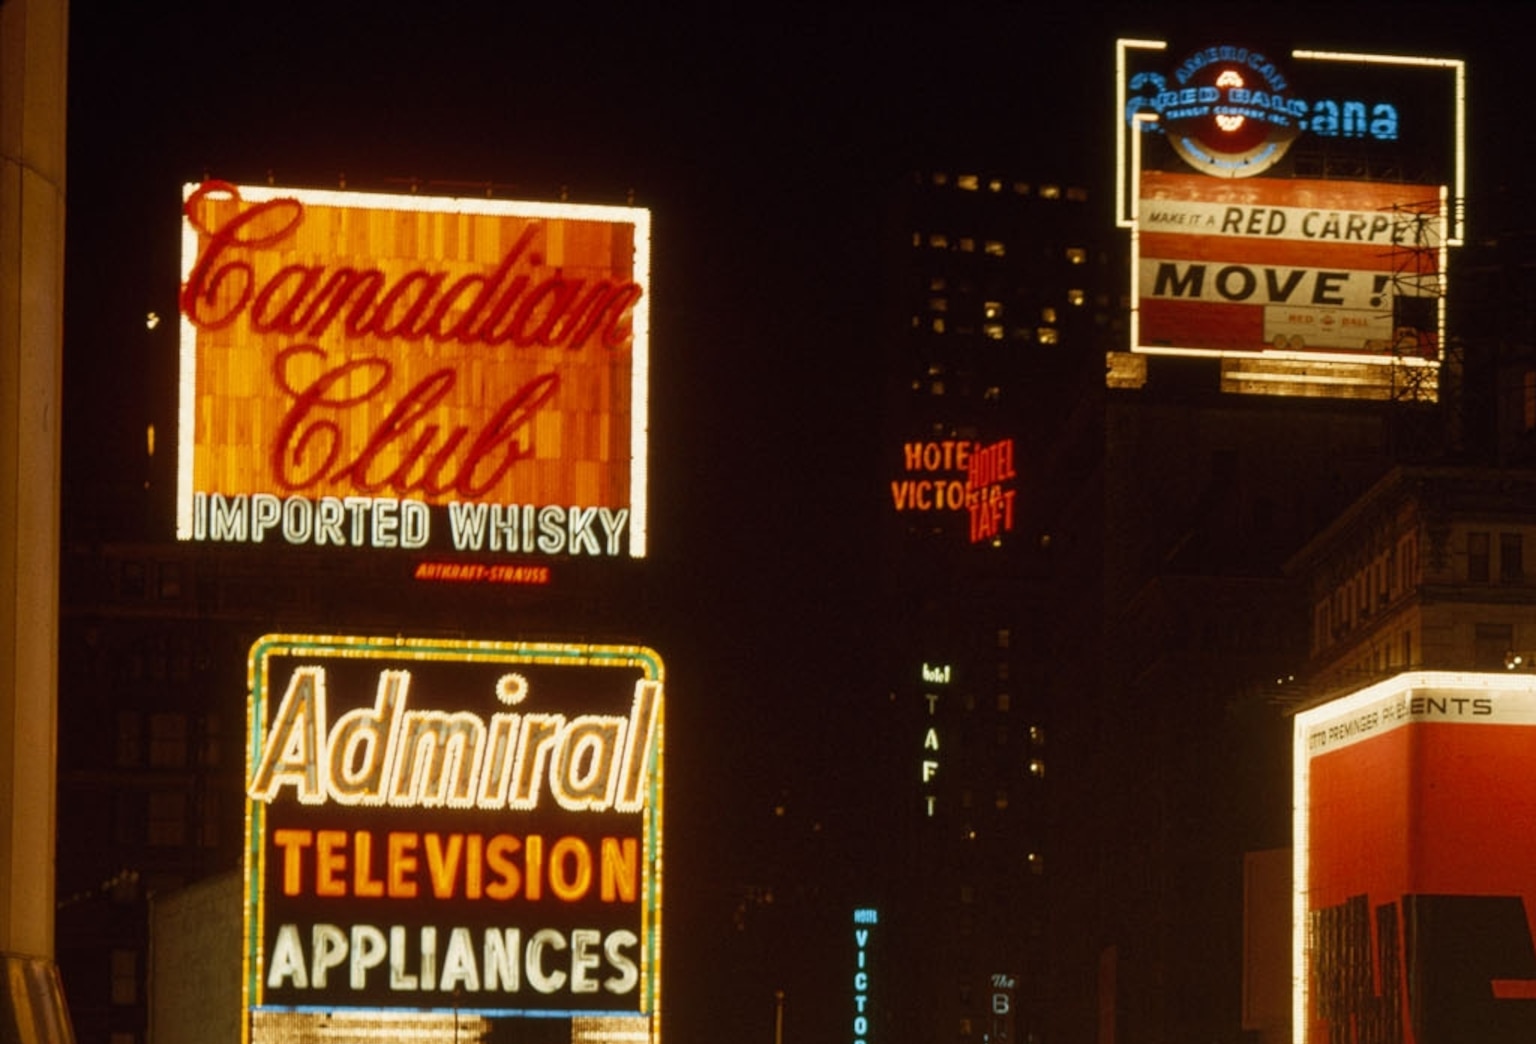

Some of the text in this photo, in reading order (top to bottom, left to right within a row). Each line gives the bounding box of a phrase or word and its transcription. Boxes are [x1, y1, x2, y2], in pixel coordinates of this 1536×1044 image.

[1221, 206, 1287, 235] RED
[180, 179, 642, 350] Canadian
[272, 343, 562, 497] Club
[904, 441, 981, 471] HOTE
[193, 492, 629, 556] IMPORTED WHISKY
[970, 489, 1016, 543] TAFT
[247, 665, 662, 812] Admiral
[923, 695, 938, 817] TAFT
[274, 829, 638, 902] TELEVISION
[267, 924, 639, 994] APPLIANCES
